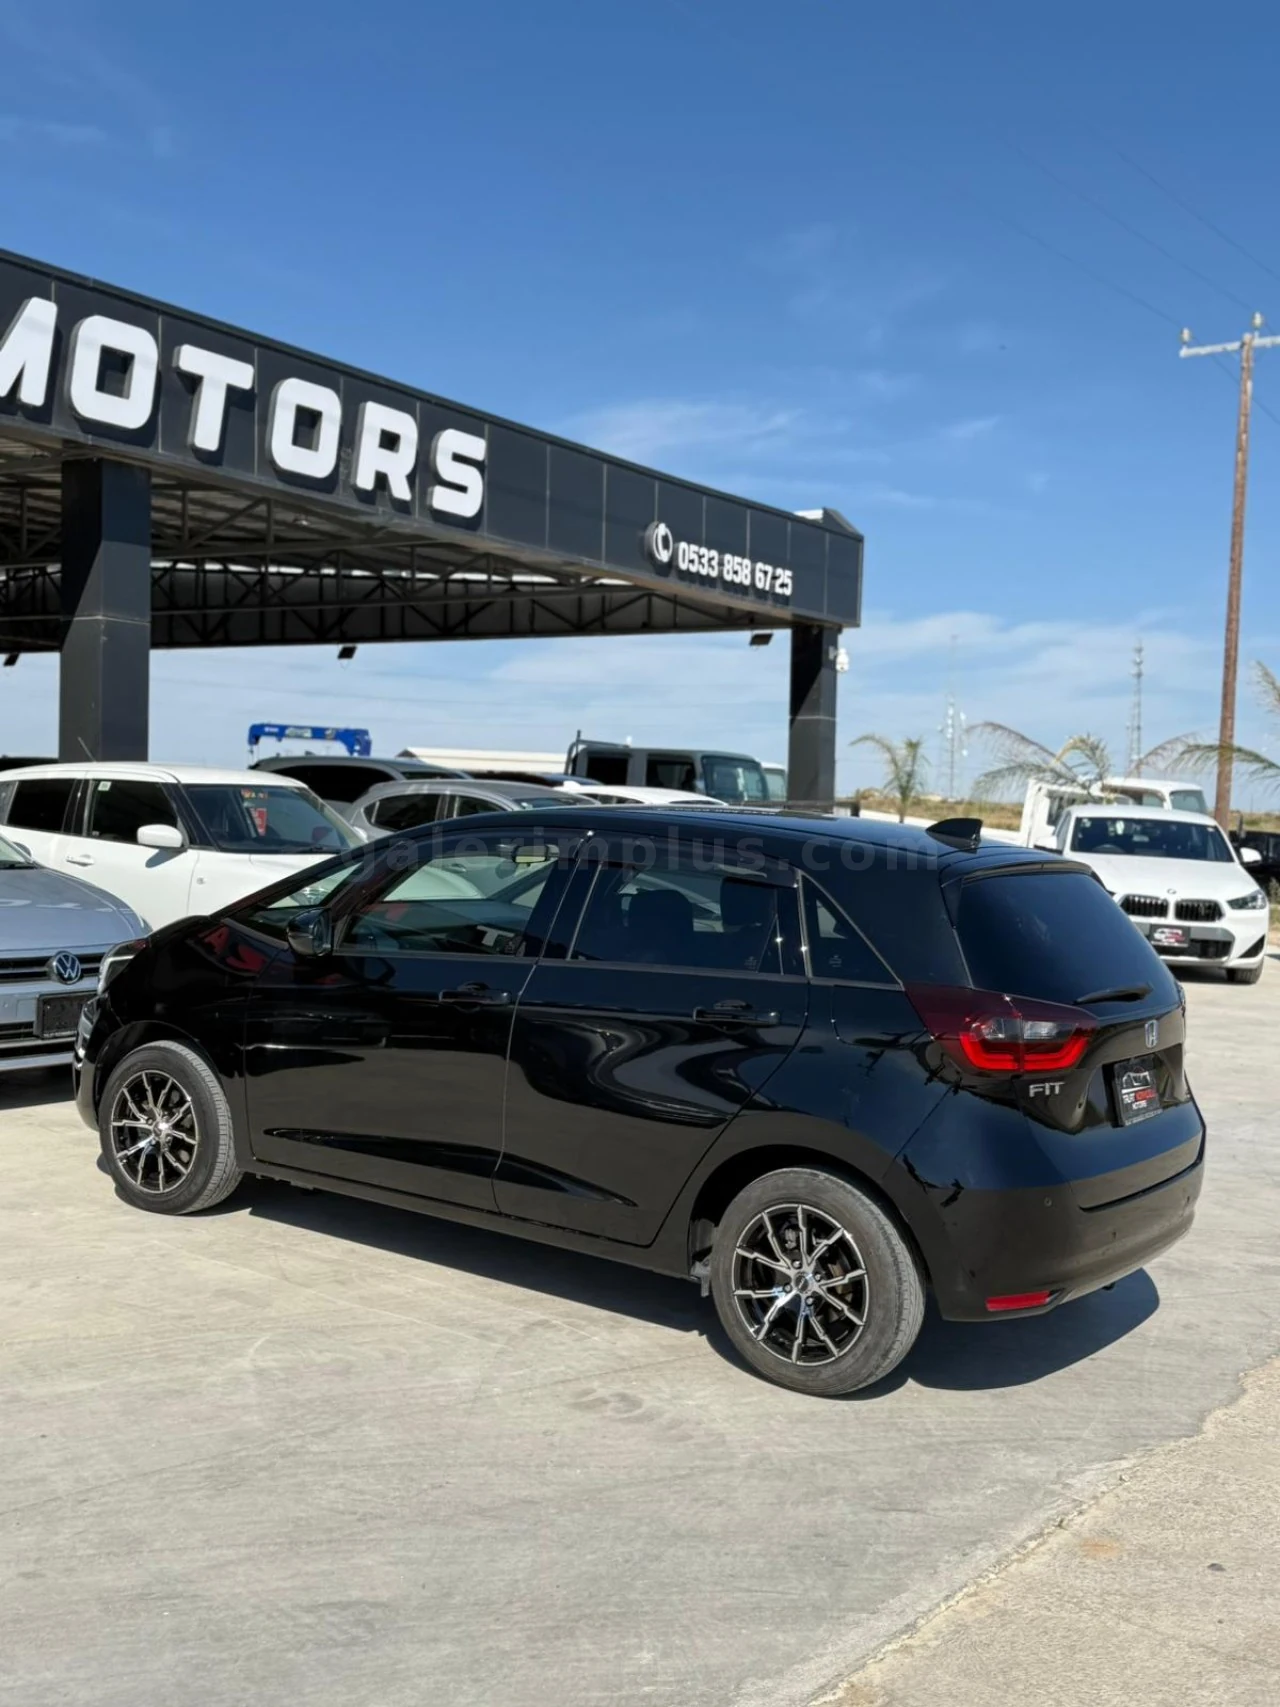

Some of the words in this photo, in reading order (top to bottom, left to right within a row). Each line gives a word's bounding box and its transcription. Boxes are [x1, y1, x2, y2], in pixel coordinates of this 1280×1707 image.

[678, 541, 718, 577] 0533
[723, 553, 751, 585] 858
[754, 562, 773, 591] 67
[774, 568, 793, 596] 25
[1029, 1081, 1065, 1097] FIT
